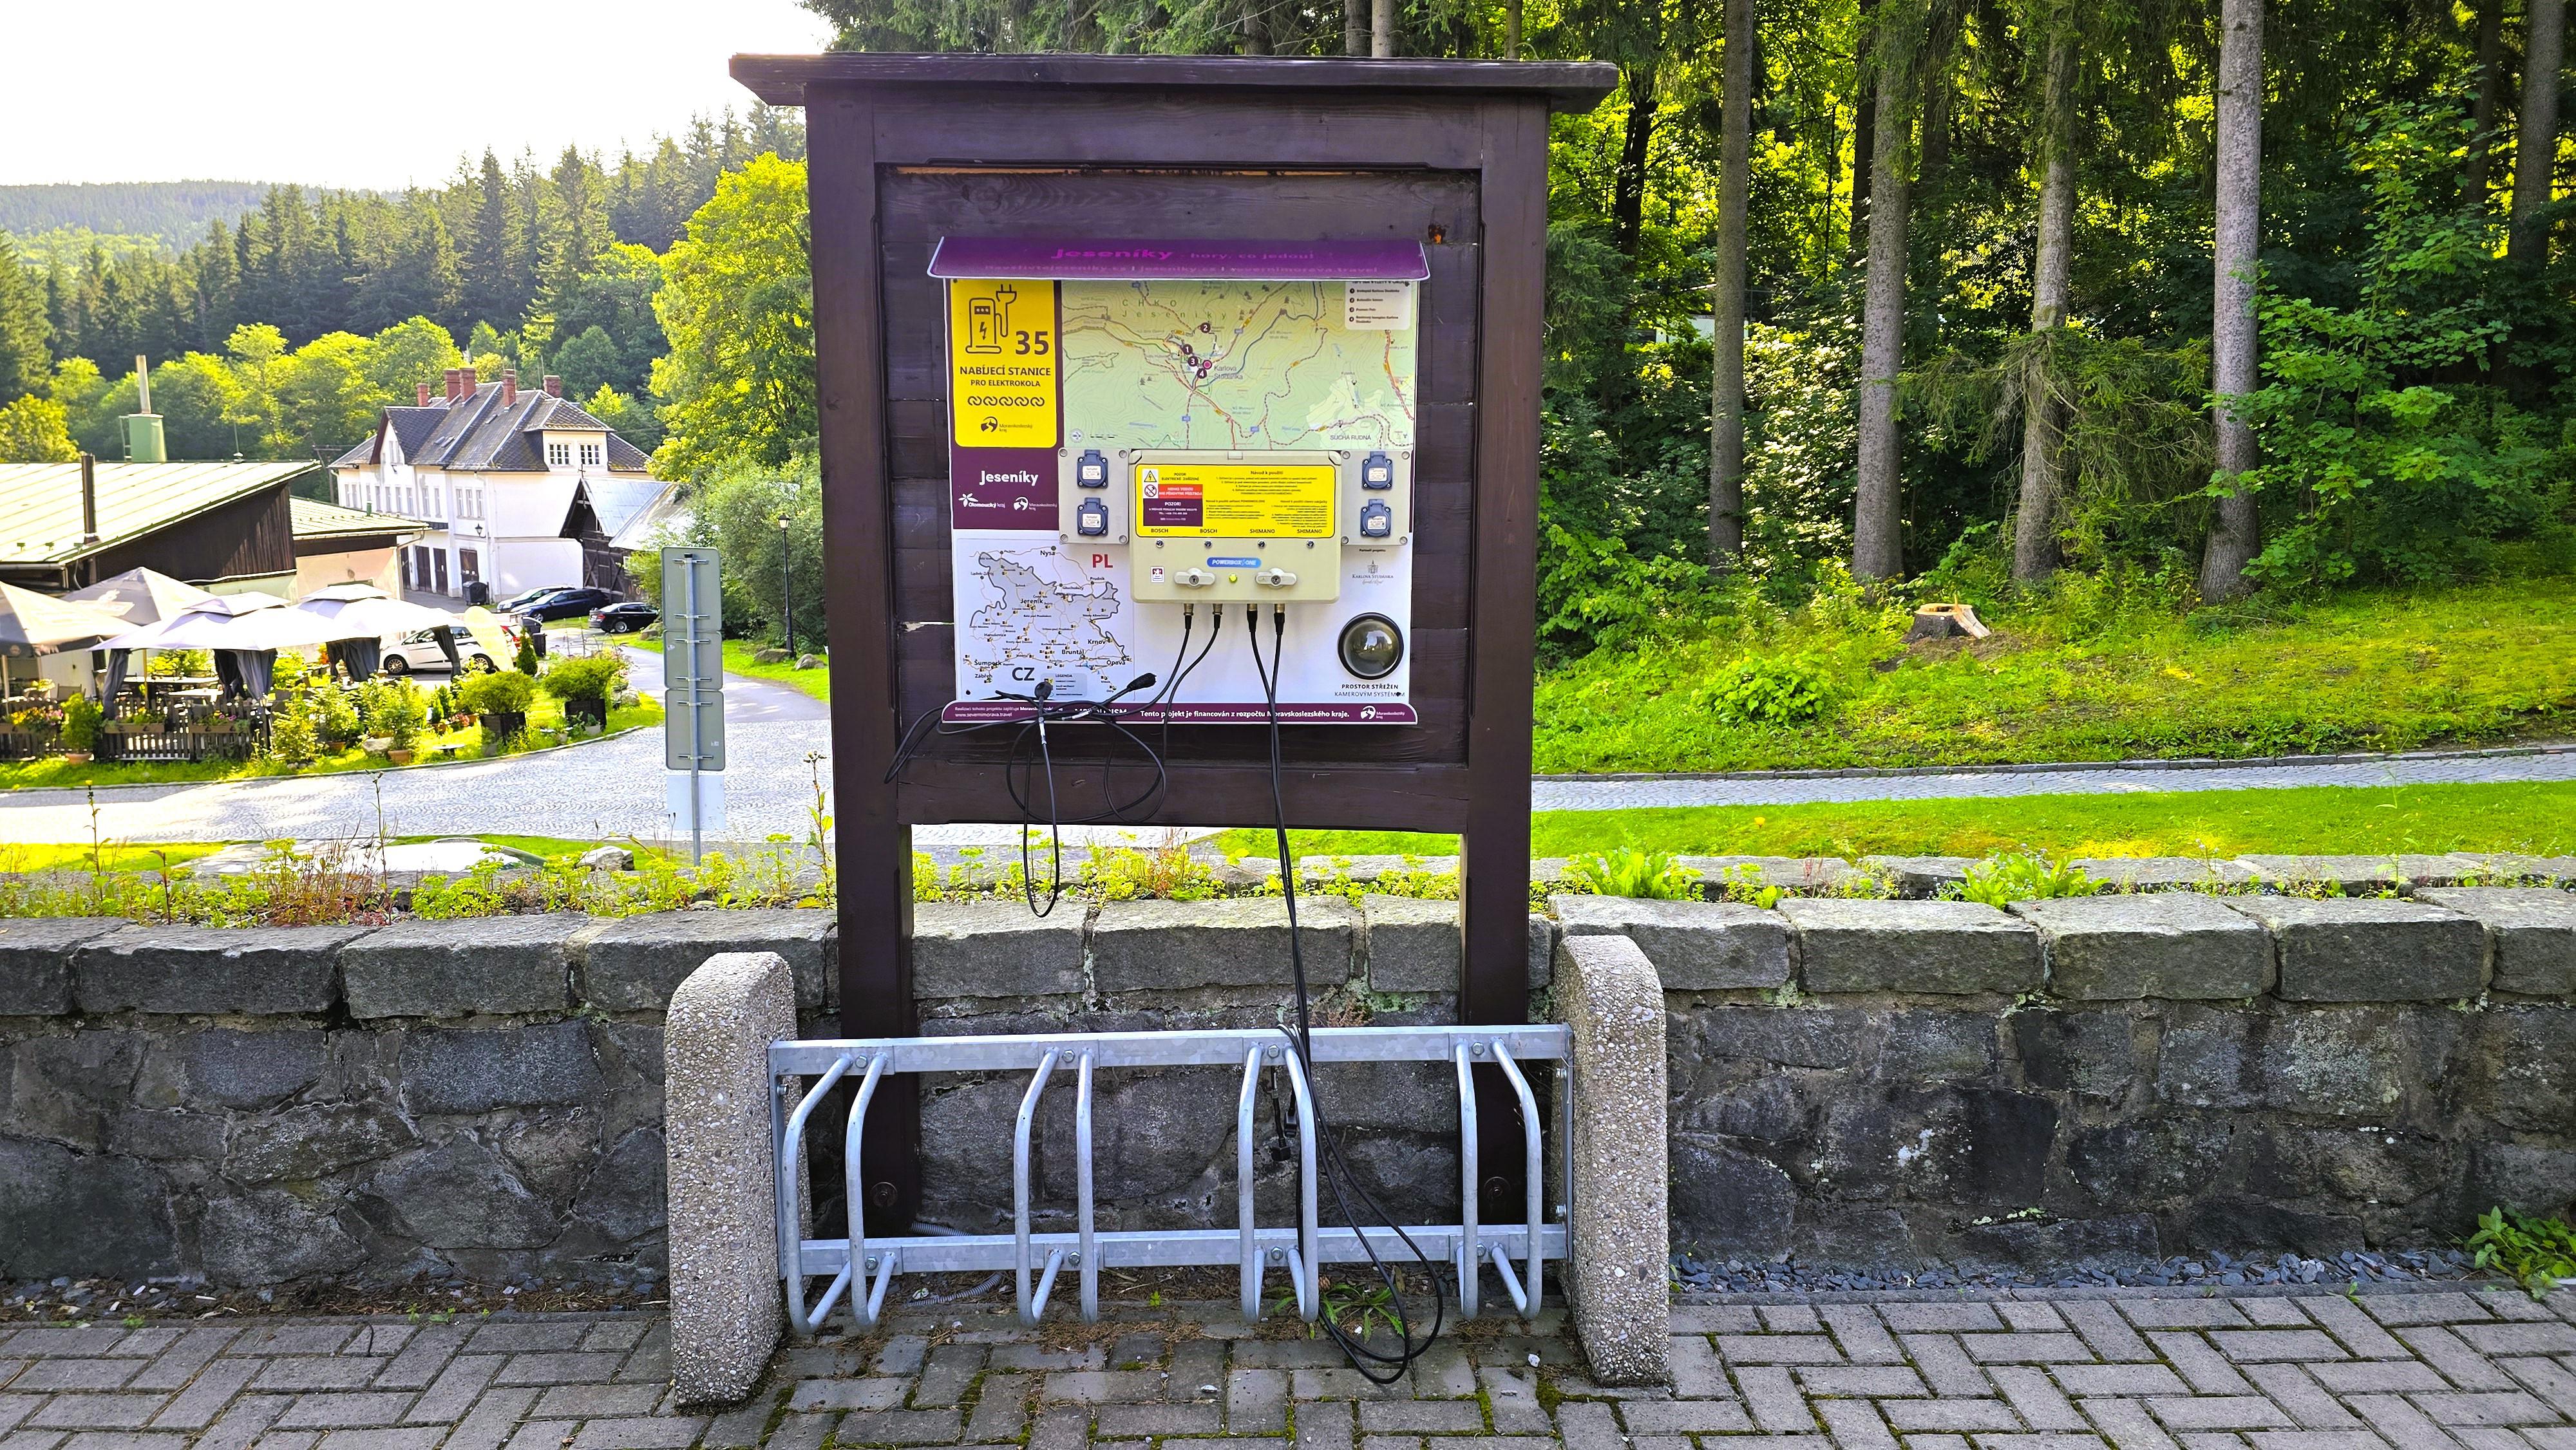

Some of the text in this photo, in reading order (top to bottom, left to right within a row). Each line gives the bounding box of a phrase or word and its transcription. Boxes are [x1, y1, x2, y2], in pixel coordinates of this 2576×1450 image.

[1051, 248, 1173, 259] Jeseníky
[1015, 330, 1049, 355] 35
[960, 364, 1051, 376] NABÍJECÍ STANICE
[979, 470, 1039, 487] Jeseníky
[1092, 554, 1113, 568] PL
[1012, 666, 1035, 681] CZ
[1160, 710, 1185, 719] pojekt
[1186, 710, 1193, 719] je
[1236, 710, 1265, 719] rozpočtu
[1331, 710, 1350, 719] kraje.
